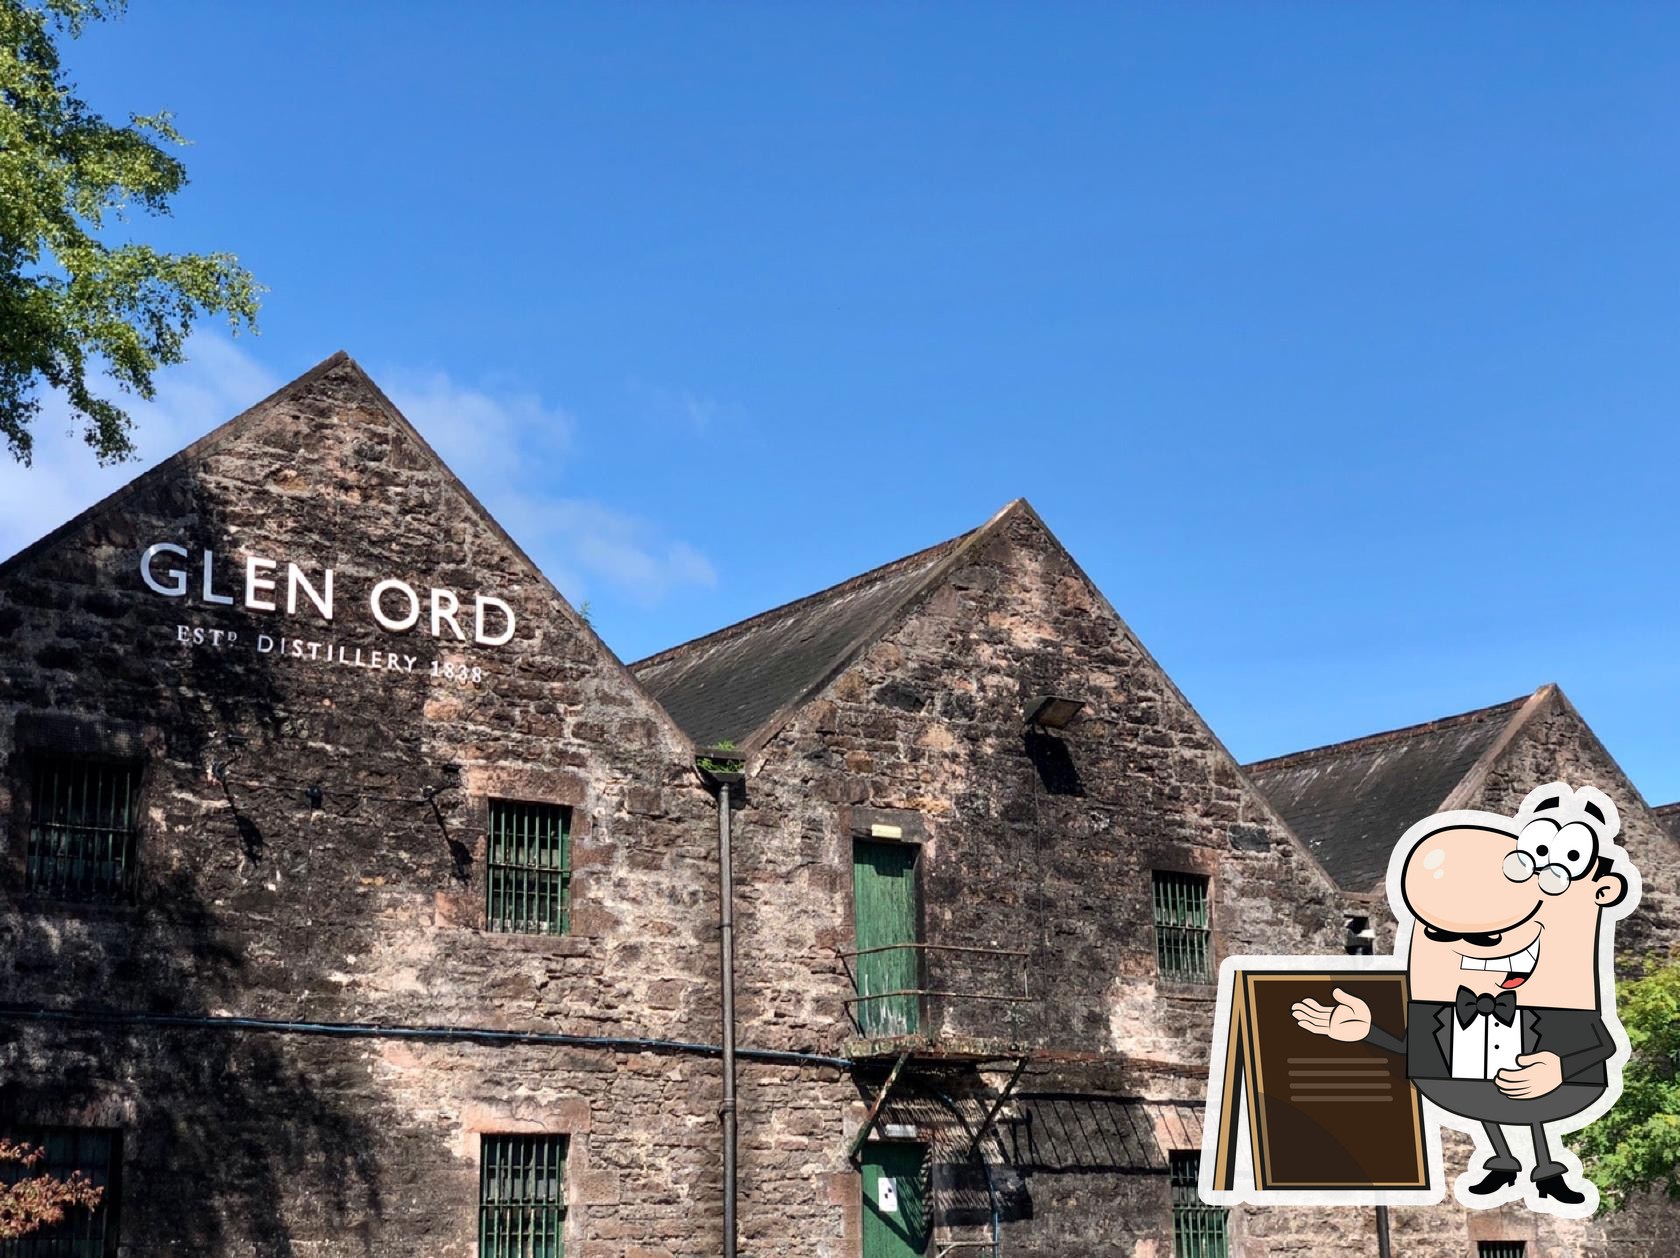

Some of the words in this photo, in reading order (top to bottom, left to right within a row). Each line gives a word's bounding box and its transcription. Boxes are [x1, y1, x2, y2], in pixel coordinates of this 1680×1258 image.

[139, 542, 334, 620] GLEN
[370, 579, 516, 646] ORD
[257, 635, 417, 673] DISTILLERY
[430, 660, 482, 684] 1838
